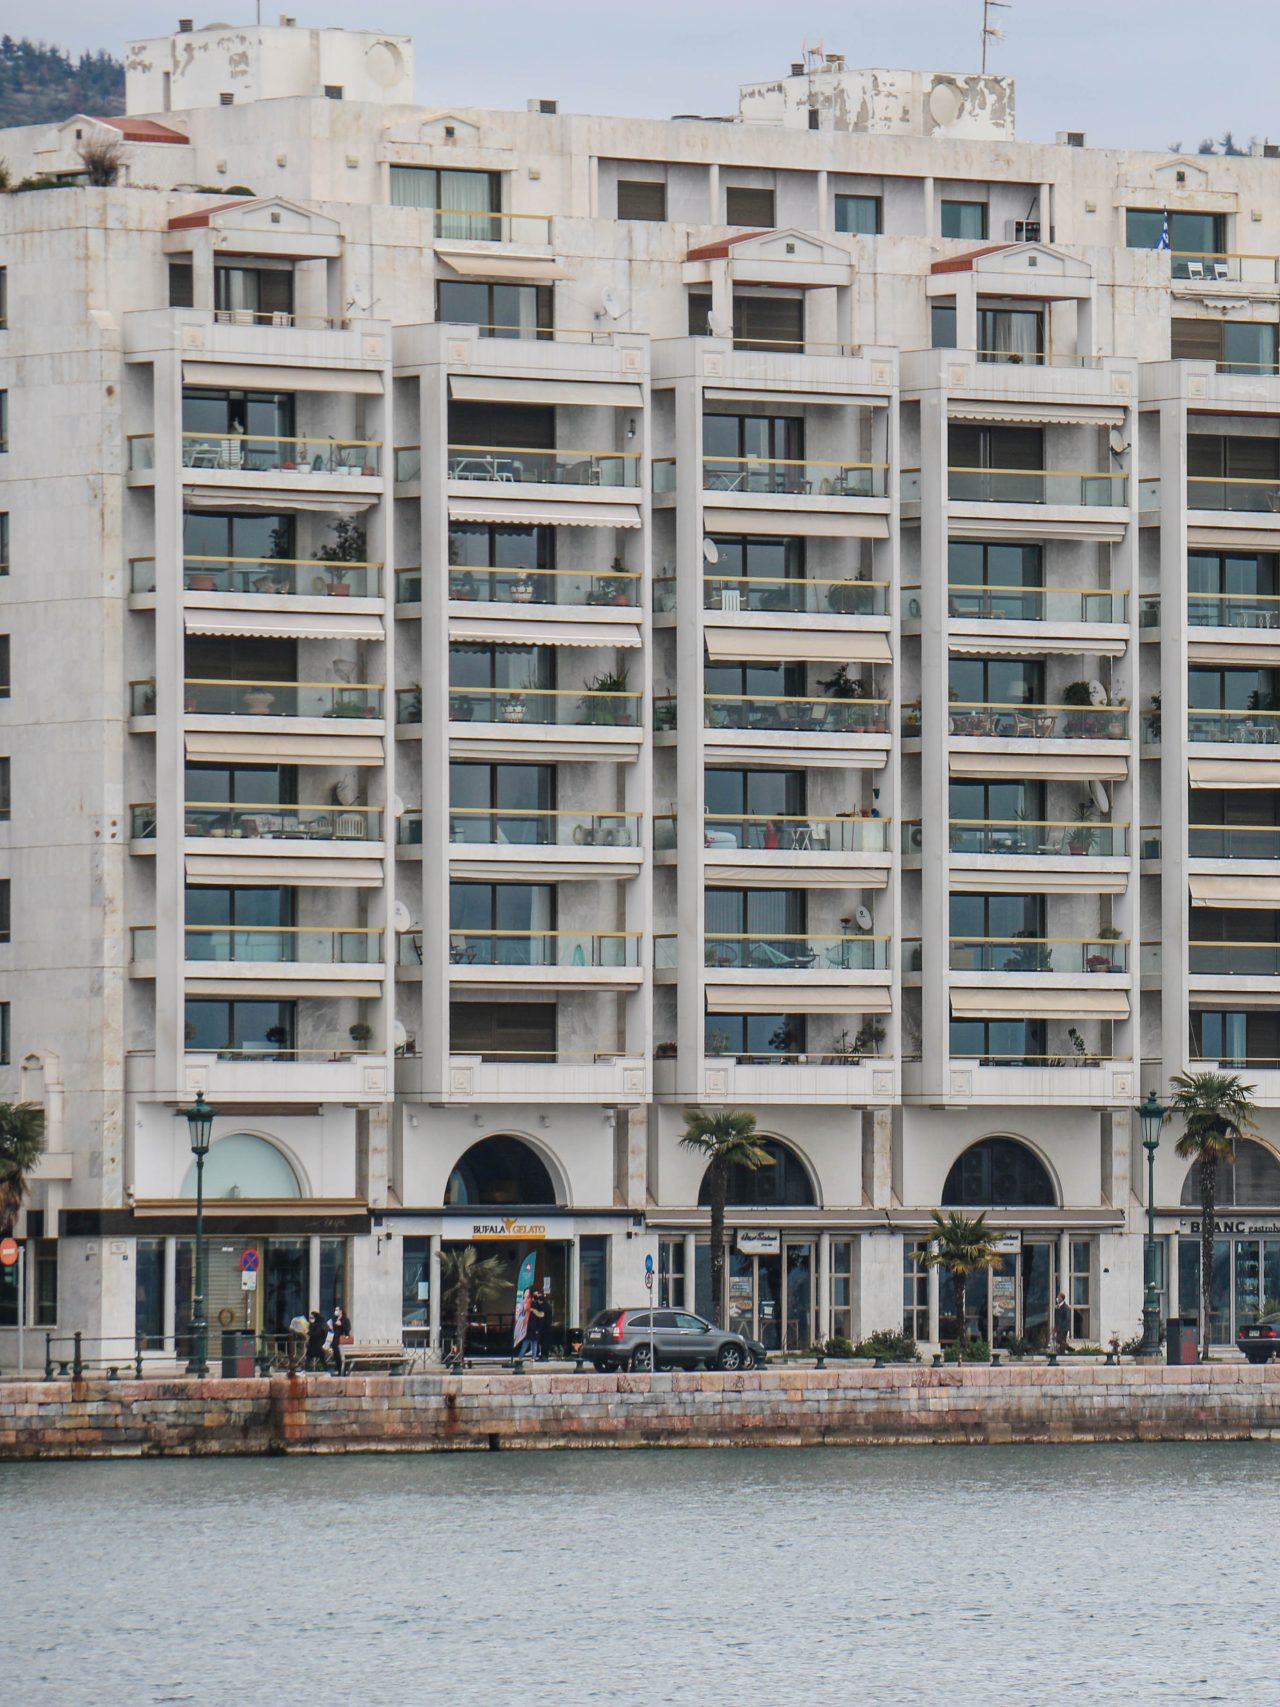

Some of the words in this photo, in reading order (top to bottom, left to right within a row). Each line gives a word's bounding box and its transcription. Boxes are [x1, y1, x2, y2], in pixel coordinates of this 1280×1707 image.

[473, 1225, 506, 1234] BUFALA
[512, 1225, 546, 1234] GELATO
[1190, 1221, 1246, 1233] BANC
